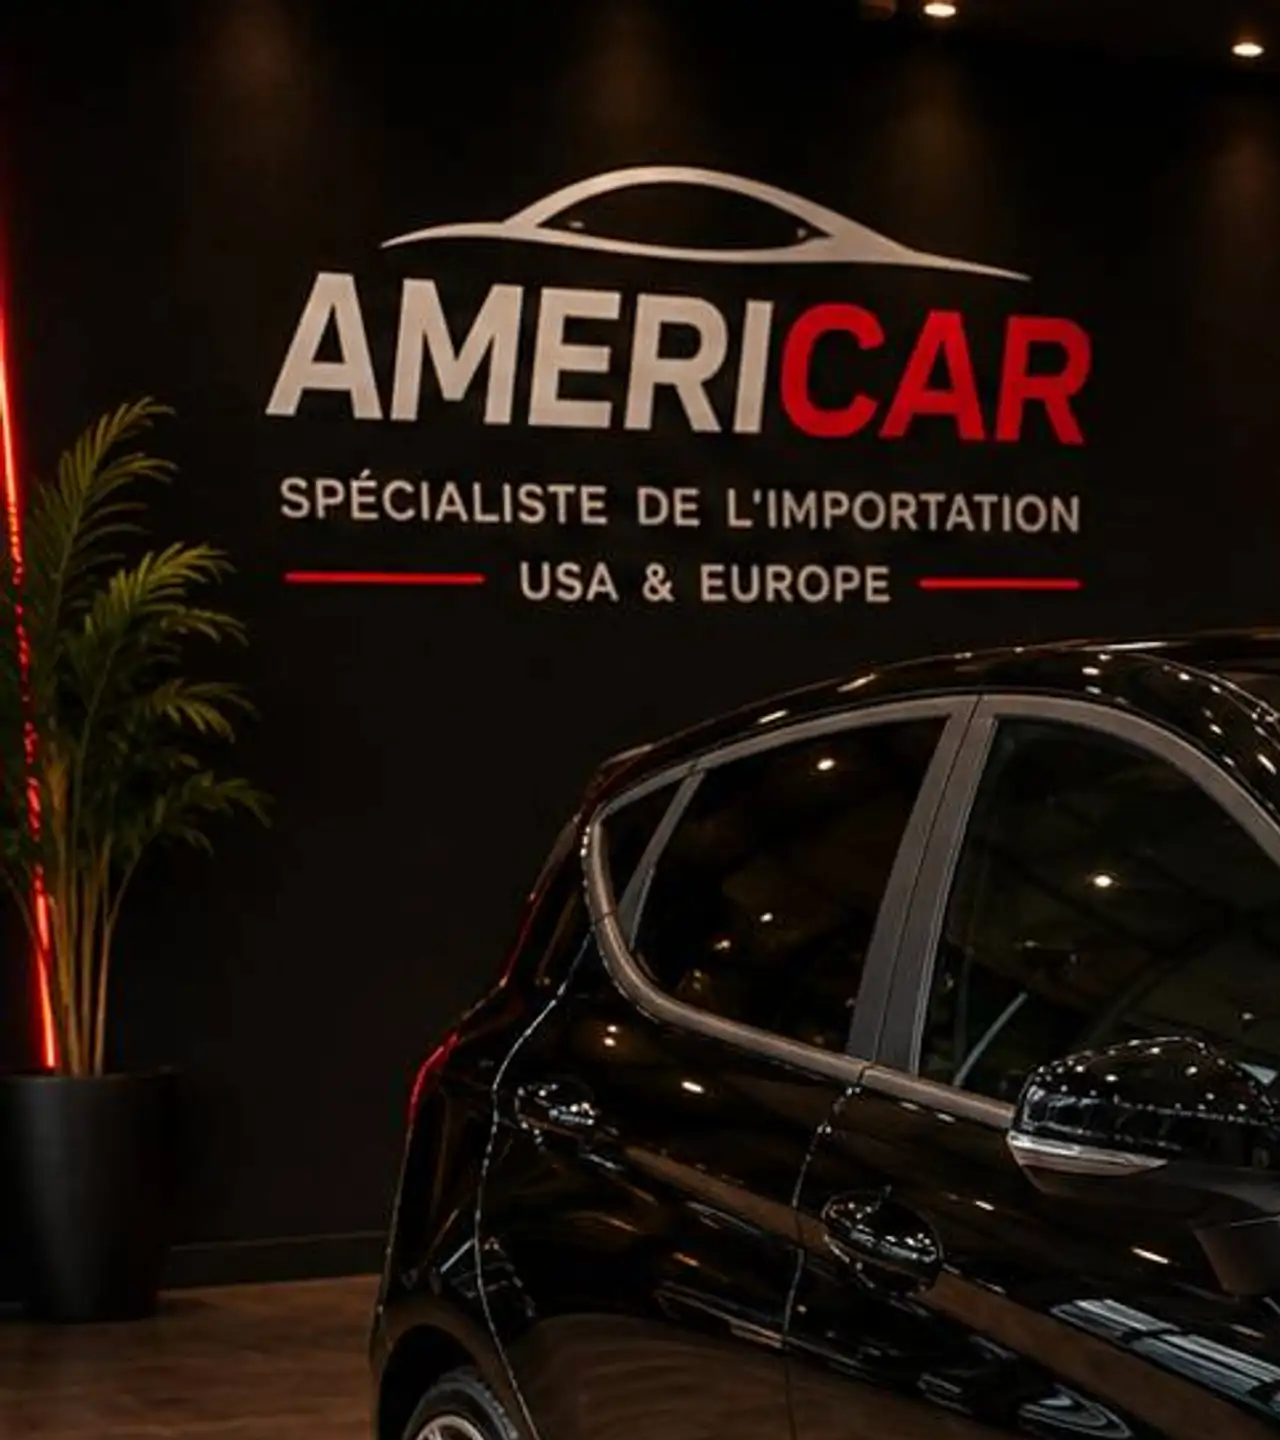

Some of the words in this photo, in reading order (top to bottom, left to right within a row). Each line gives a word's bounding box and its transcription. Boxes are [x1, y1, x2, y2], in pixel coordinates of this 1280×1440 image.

[265, 271, 1091, 445] AMERICAR
[279, 468, 608, 527] SPÉCIALISTE
[637, 485, 701, 528] DE
[727, 487, 1080, 533] L'IMPORTATION
[519, 561, 619, 602] USA
[642, 561, 675, 602] &
[700, 563, 891, 603] EUROPE
